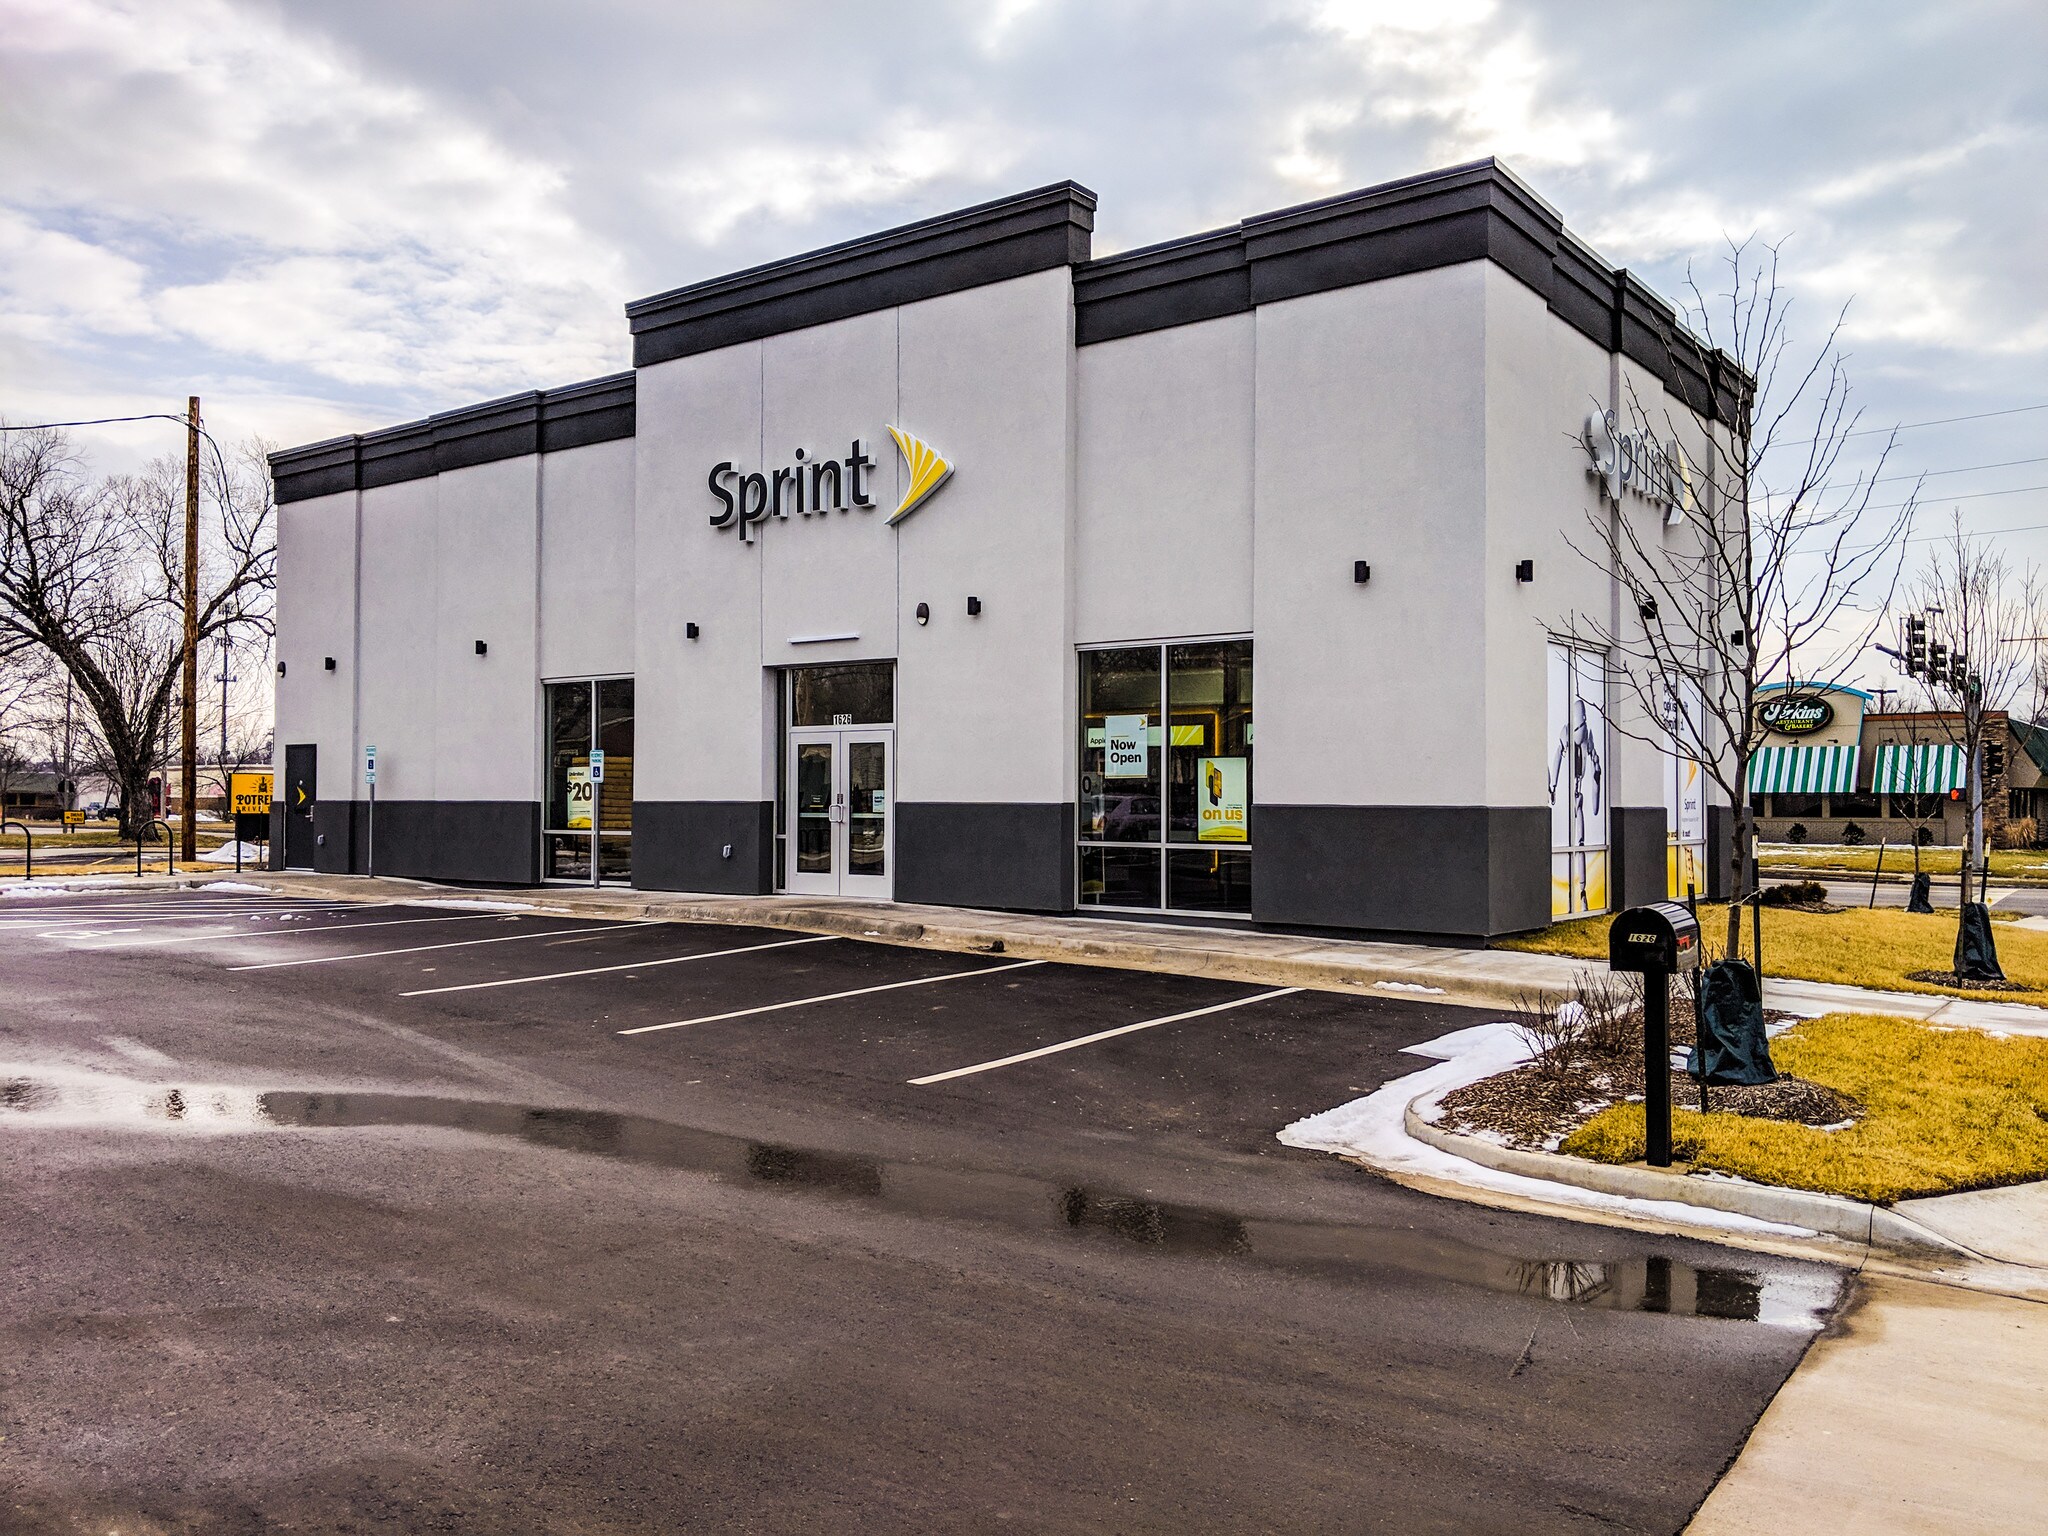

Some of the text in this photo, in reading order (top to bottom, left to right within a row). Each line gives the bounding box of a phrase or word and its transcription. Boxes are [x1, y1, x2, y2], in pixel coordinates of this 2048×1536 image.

[708, 438, 877, 543] Sprint
[834, 714, 851, 725] 1626
[1110, 739, 1136, 750] Now
[1110, 752, 1142, 765] Open
[566, 781, 592, 801] $20
[1202, 809, 1243, 820] on us
[1629, 934, 1656, 943] 1626
